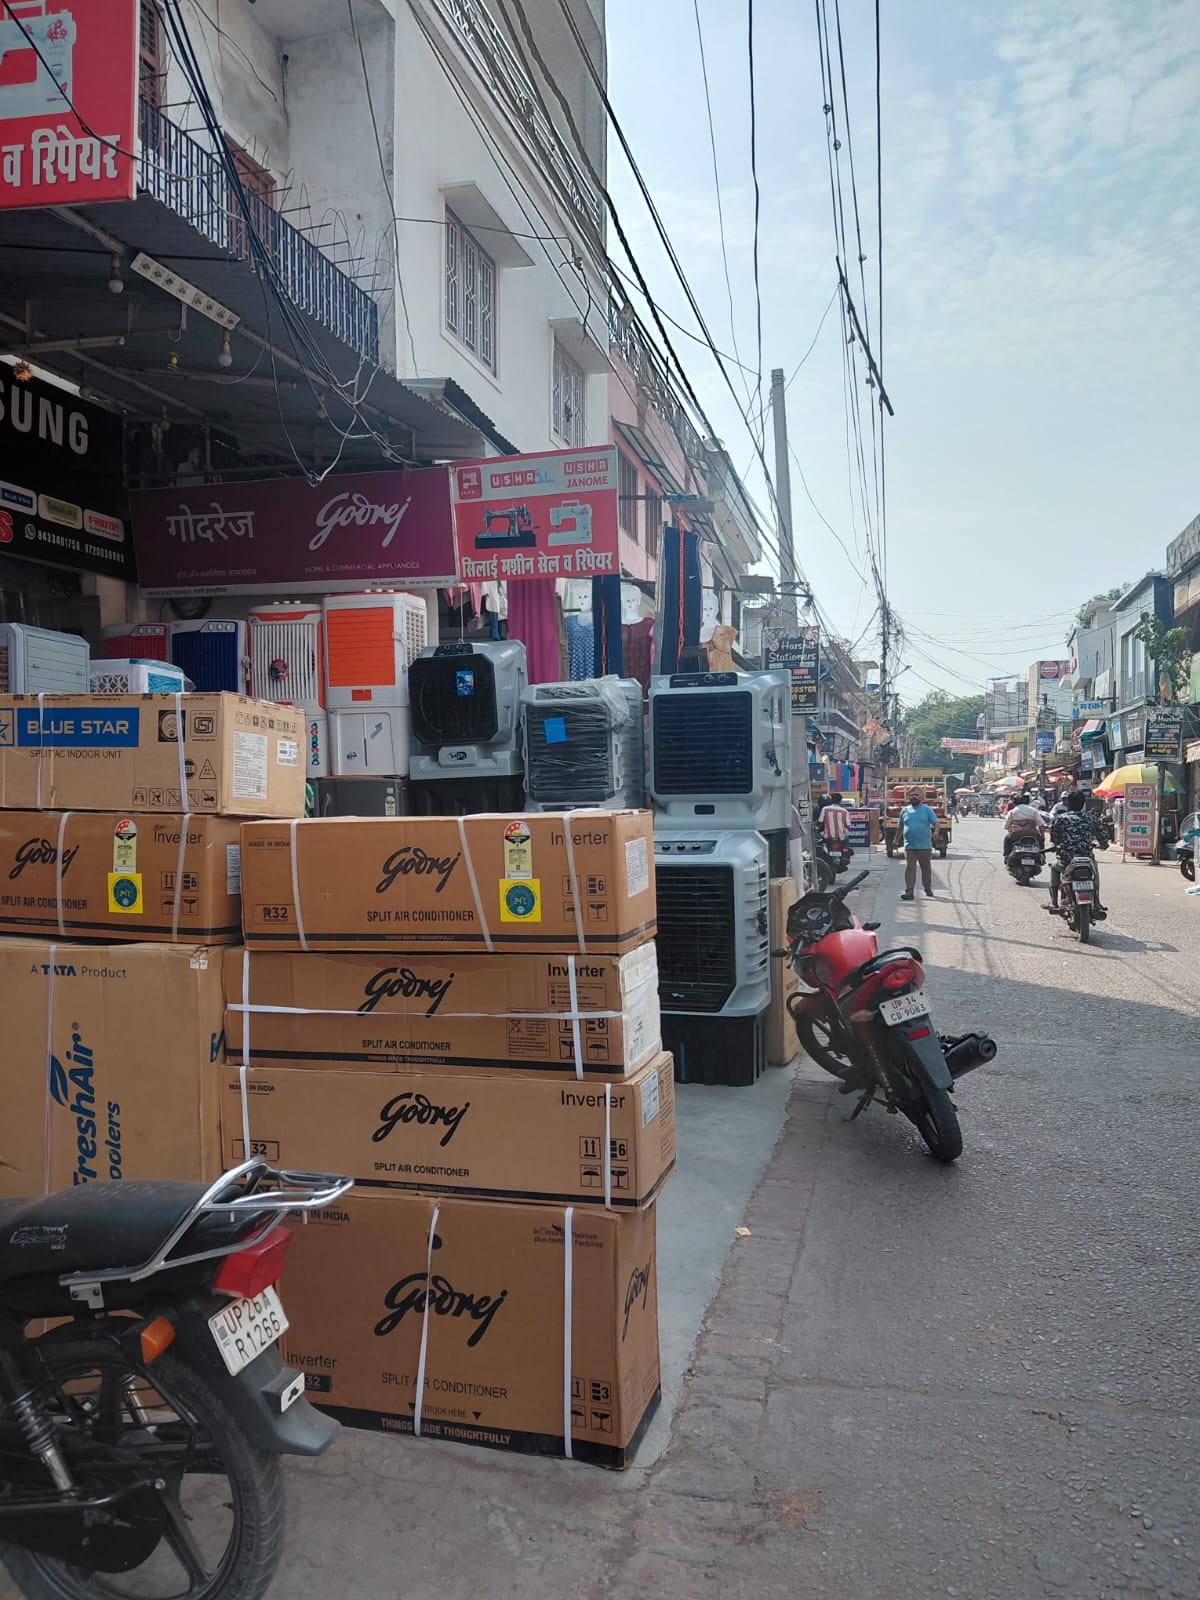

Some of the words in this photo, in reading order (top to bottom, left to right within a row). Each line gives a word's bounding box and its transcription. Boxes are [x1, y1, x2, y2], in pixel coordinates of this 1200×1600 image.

[3, 144, 24, 187] व
[31, 125, 120, 185] रिपेयर
[0, 380, 89, 455] UNG
[565, 459, 608, 475] USHA
[491, 472, 536, 487] USHA
[567, 476, 609, 488] JANOME
[166, 502, 255, 542] गोदरेज
[308, 492, 412, 551] Godrej
[305, 565, 324, 574] HOME
[331, 562, 376, 572] COMMERCIAL
[378, 560, 421, 570] APPLIANCES
[462, 554, 498, 578] सिलाई
[501, 552, 534, 576] मशीन
[538, 551, 560, 574] सेल
[563, 554, 572, 573] व
[575, 548, 613, 571] रिपेयर
[27, 720, 74, 734] BLUE
[81, 720, 129, 734] STAR
[30, 749, 51, 758] SPLIT
[54, 750, 65, 758] AC
[67, 750, 100, 759] INDOOR
[102, 750, 121, 759] UNIT
[154, 830, 203, 845] Inveter
[551, 831, 609, 846] Inerter
[375, 846, 462, 894] Godrej
[598, 880, 605, 892] 6
[1, 896, 21, 906] SPLIT
[23, 898, 35, 906] AIR
[37, 898, 88, 910] CONDTIONER
[263, 906, 289, 920] R32
[367, 910, 391, 922] SPLIT
[394, 911, 410, 922] AIR
[412, 910, 474, 922] CONDITIONER
[31, 965, 38, 974] A
[81, 965, 127, 978] Product
[356, 967, 455, 1018] Godrej
[891, 999, 903, 1010] UP
[362, 1040, 383, 1049] SPLIT
[385, 1041, 397, 1050] AIR
[399, 1041, 451, 1051] CONDITIONER
[372, 1092, 470, 1147] Godrej
[618, 1143, 626, 1156] 6
[374, 1162, 396, 1173] SPLIT
[398, 1164, 412, 1174] AIR
[413, 1165, 470, 1177] CONDITIONER
[310, 1209, 320, 1219] IN
[323, 1211, 350, 1222] INDIA
[374, 1272, 508, 1347] Godrej
[234, 1311, 281, 1363] R1266
[286, 1352, 337, 1369] Inverter
[382, 1373, 410, 1387] SPLIT
[433, 1376, 508, 1399] CONDITIONER
[601, 1388, 609, 1400] 3
[381, 1418, 412, 1430] THINGS
[423, 1424, 441, 1435] ADE
[444, 1426, 511, 1445] THOUGHTFULLY
